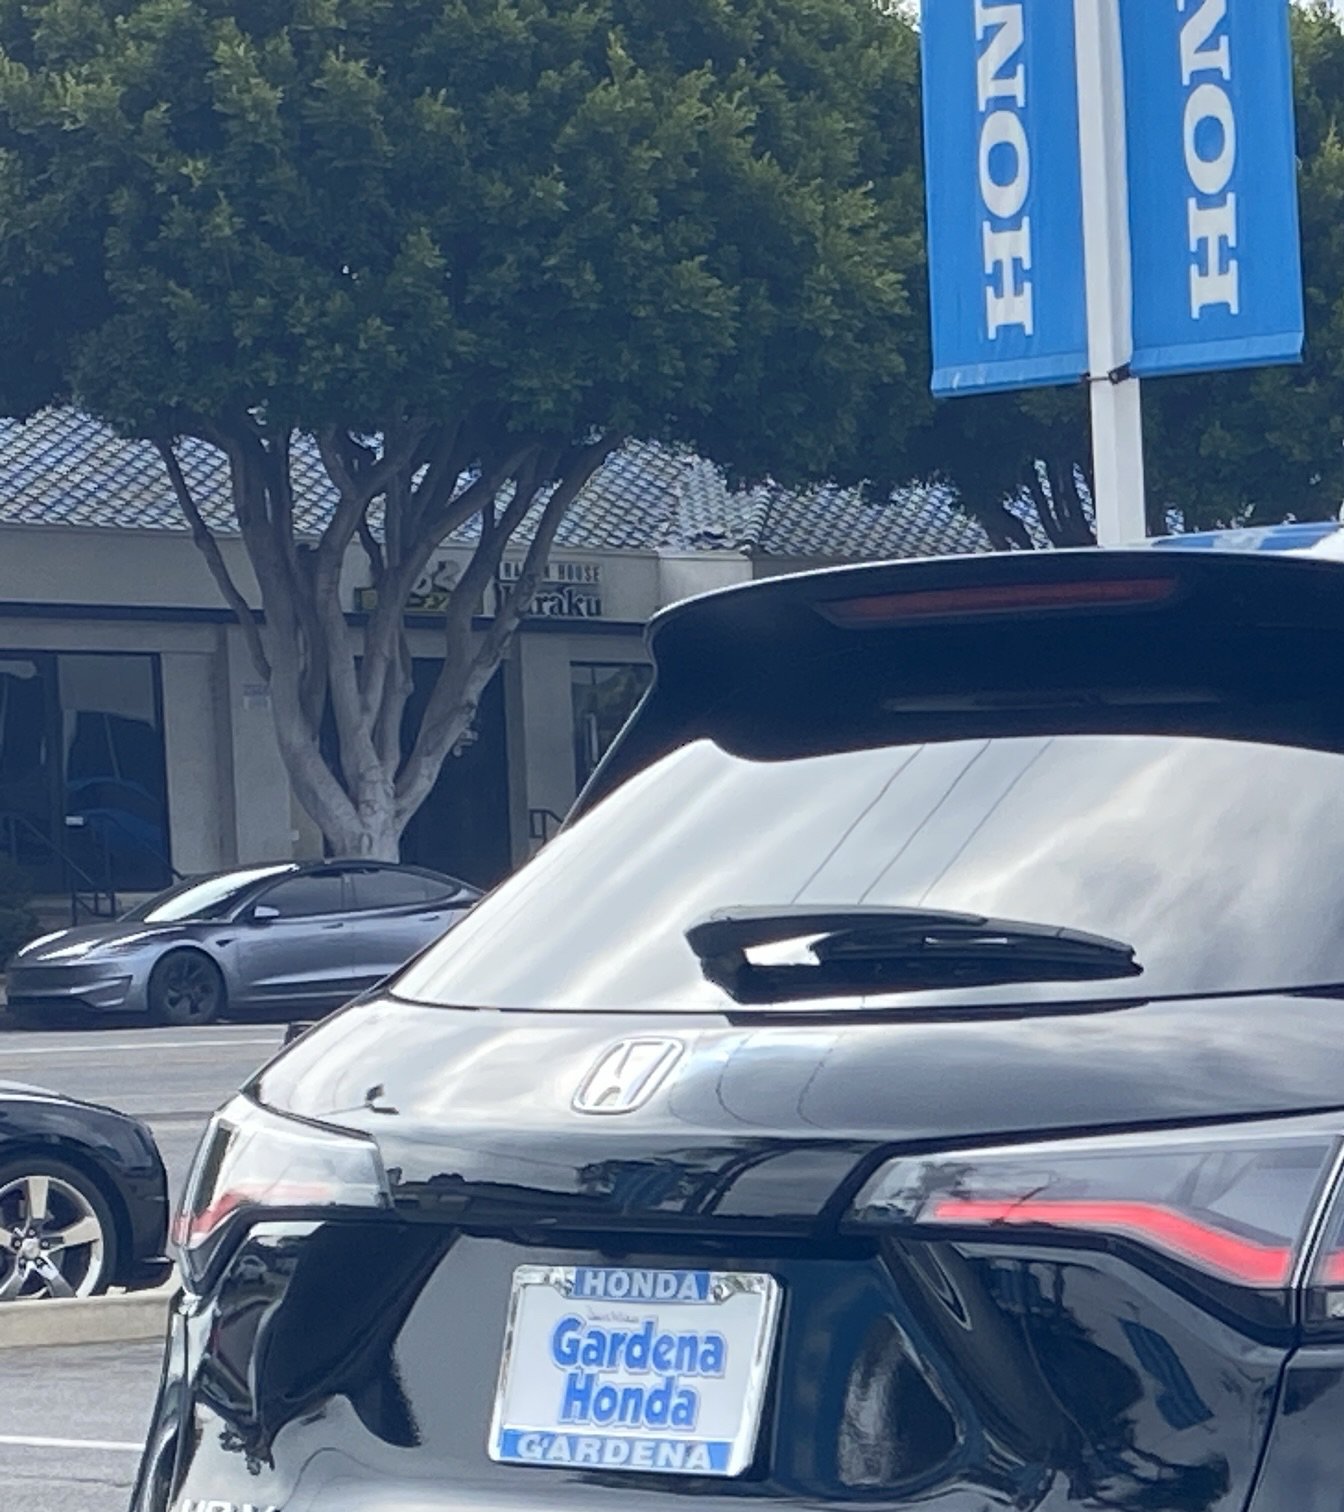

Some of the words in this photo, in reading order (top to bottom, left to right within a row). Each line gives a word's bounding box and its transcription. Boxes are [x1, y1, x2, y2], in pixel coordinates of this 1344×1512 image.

[558, 563, 600, 582] HOUSE
[583, 1270, 700, 1300] HONDA
[552, 1317, 725, 1374] Gardena
[561, 1372, 698, 1427] Honda
[516, 1434, 713, 1470] GARDENA
